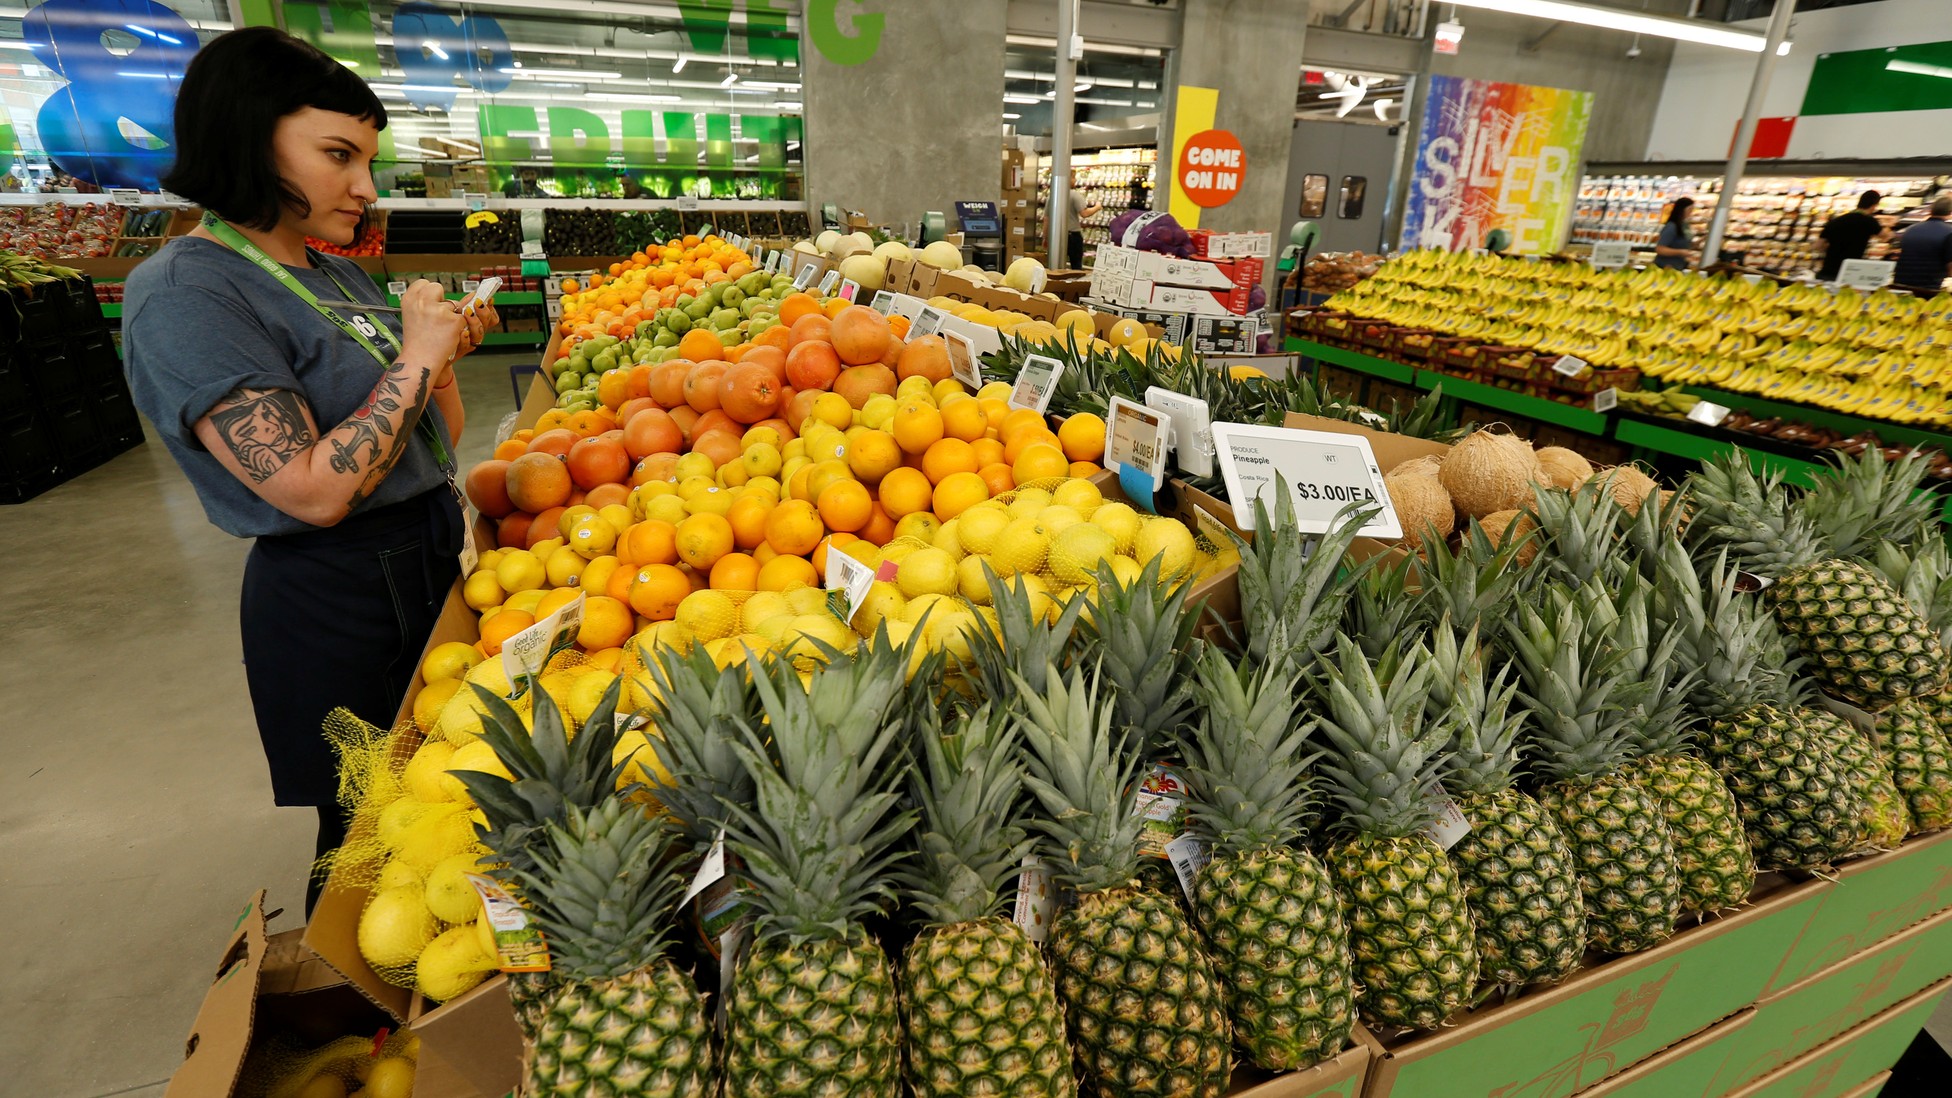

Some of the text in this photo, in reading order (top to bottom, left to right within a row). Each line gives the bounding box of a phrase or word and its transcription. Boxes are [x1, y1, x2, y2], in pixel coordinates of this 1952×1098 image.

[478, 103, 800, 200] FRUIT
[1187, 146, 1241, 168] COME
[1185, 170, 1238, 191] ON IN
[1230, 445, 1260, 454] PRODUCE
[1233, 454, 1270, 465] Pineapple
[1324, 455, 1337, 463] WT
[1297, 481, 1378, 504] $3.00/EA
[512, 633, 546, 656] organic
[514, 632, 529, 649] Good
